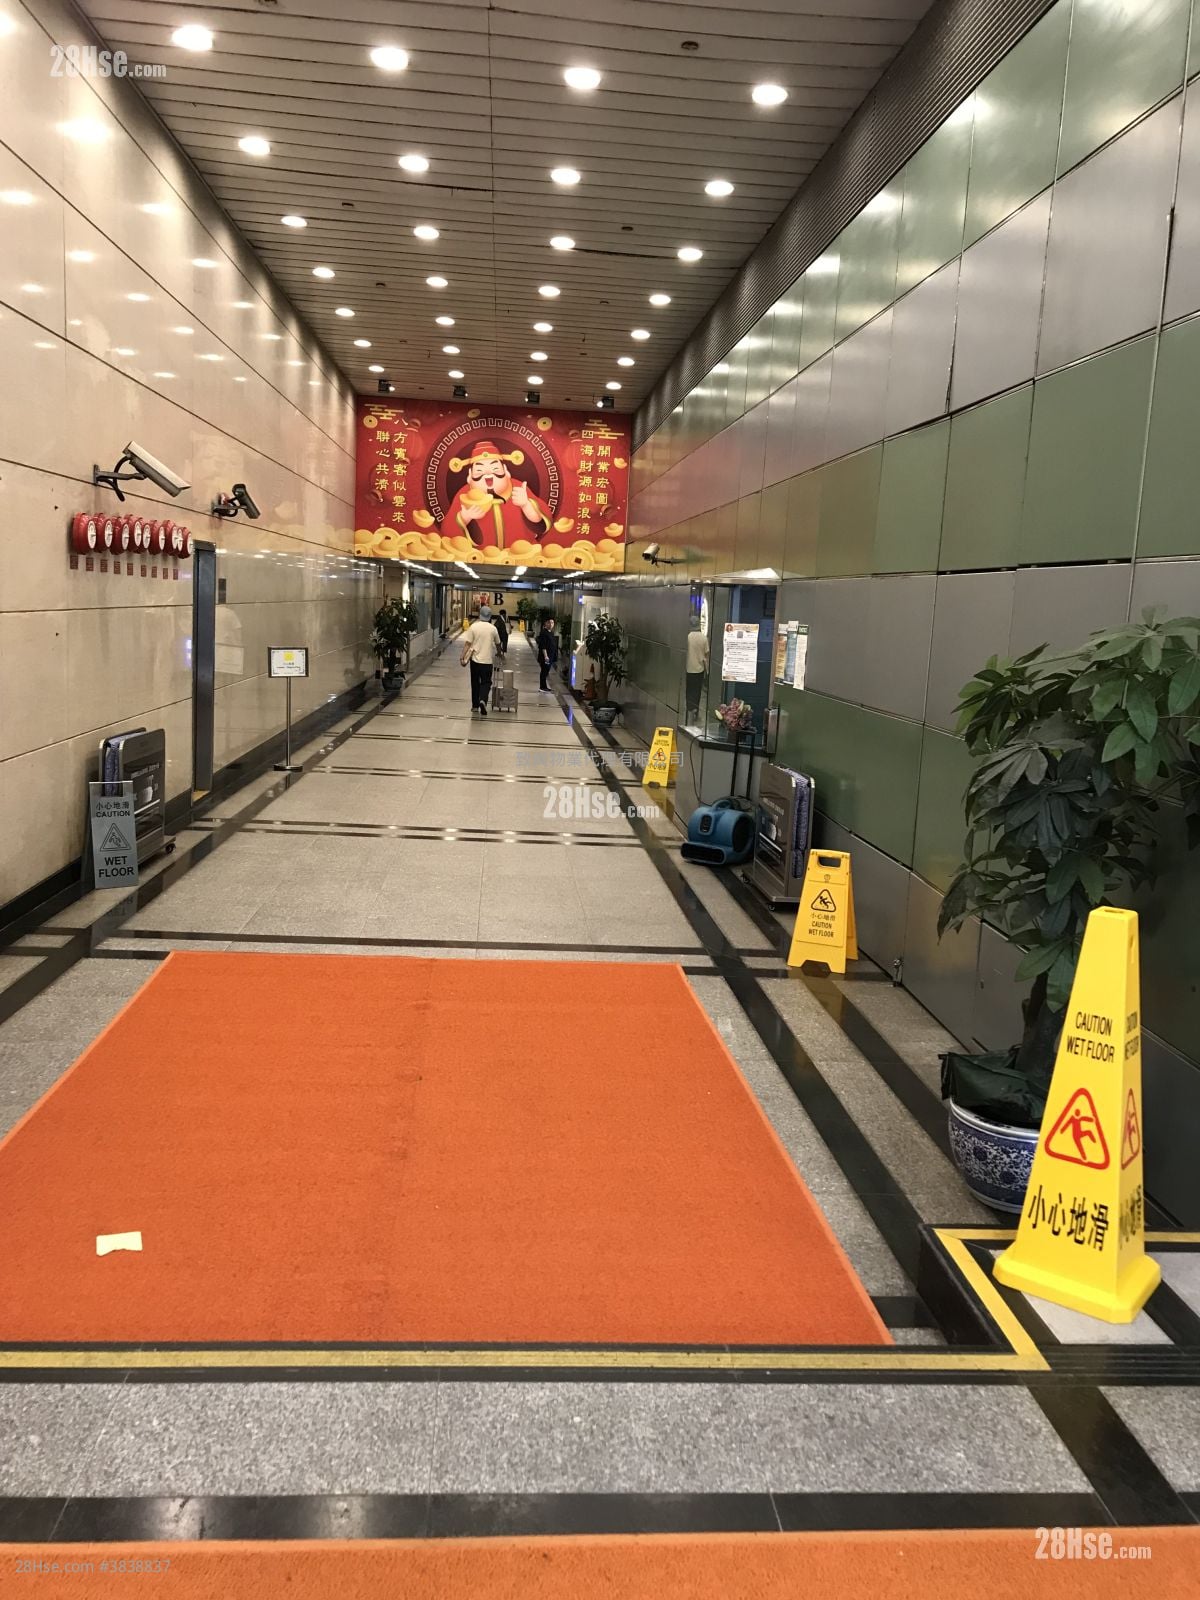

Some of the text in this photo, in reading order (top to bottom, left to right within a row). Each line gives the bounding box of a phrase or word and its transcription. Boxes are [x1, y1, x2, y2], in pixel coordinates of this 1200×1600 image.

[392, 418, 408, 523] 八方賓客似雲來
[576, 429, 595, 535] 四海財源如浪湧
[596, 445, 611, 504] 開業宏圖
[493, 592, 504, 605] B
[96, 810, 130, 818] CAUTION
[98, 866, 135, 878] FLOOR
[104, 855, 128, 866] WET
[811, 921, 833, 929] CAUTION
[1075, 1011, 1113, 1037] CAUTION
[1066, 1034, 1086, 1056] WET
[1086, 1039, 1116, 1063] FLOOR
[1027, 1184, 1109, 1252] 小心地滑
